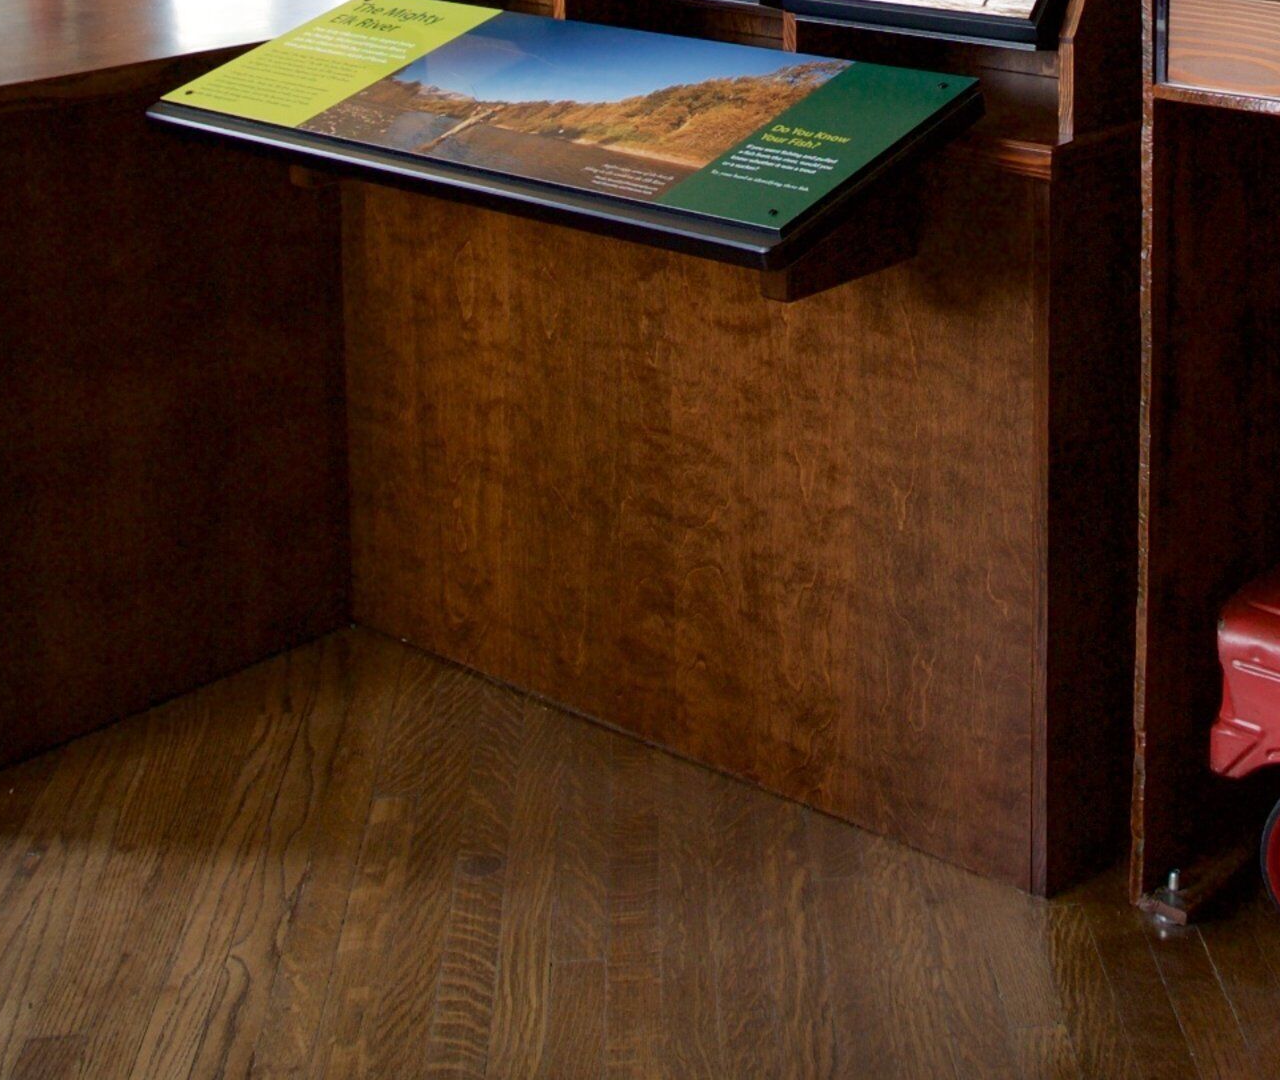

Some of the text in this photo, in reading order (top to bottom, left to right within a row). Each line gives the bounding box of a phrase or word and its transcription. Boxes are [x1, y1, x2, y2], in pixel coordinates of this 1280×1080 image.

[354, 2, 444, 25] The Mighty
[330, 14, 401, 32] Elk River
[761, 133, 822, 149] Your Fish?
[771, 125, 851, 144] Do You Know
